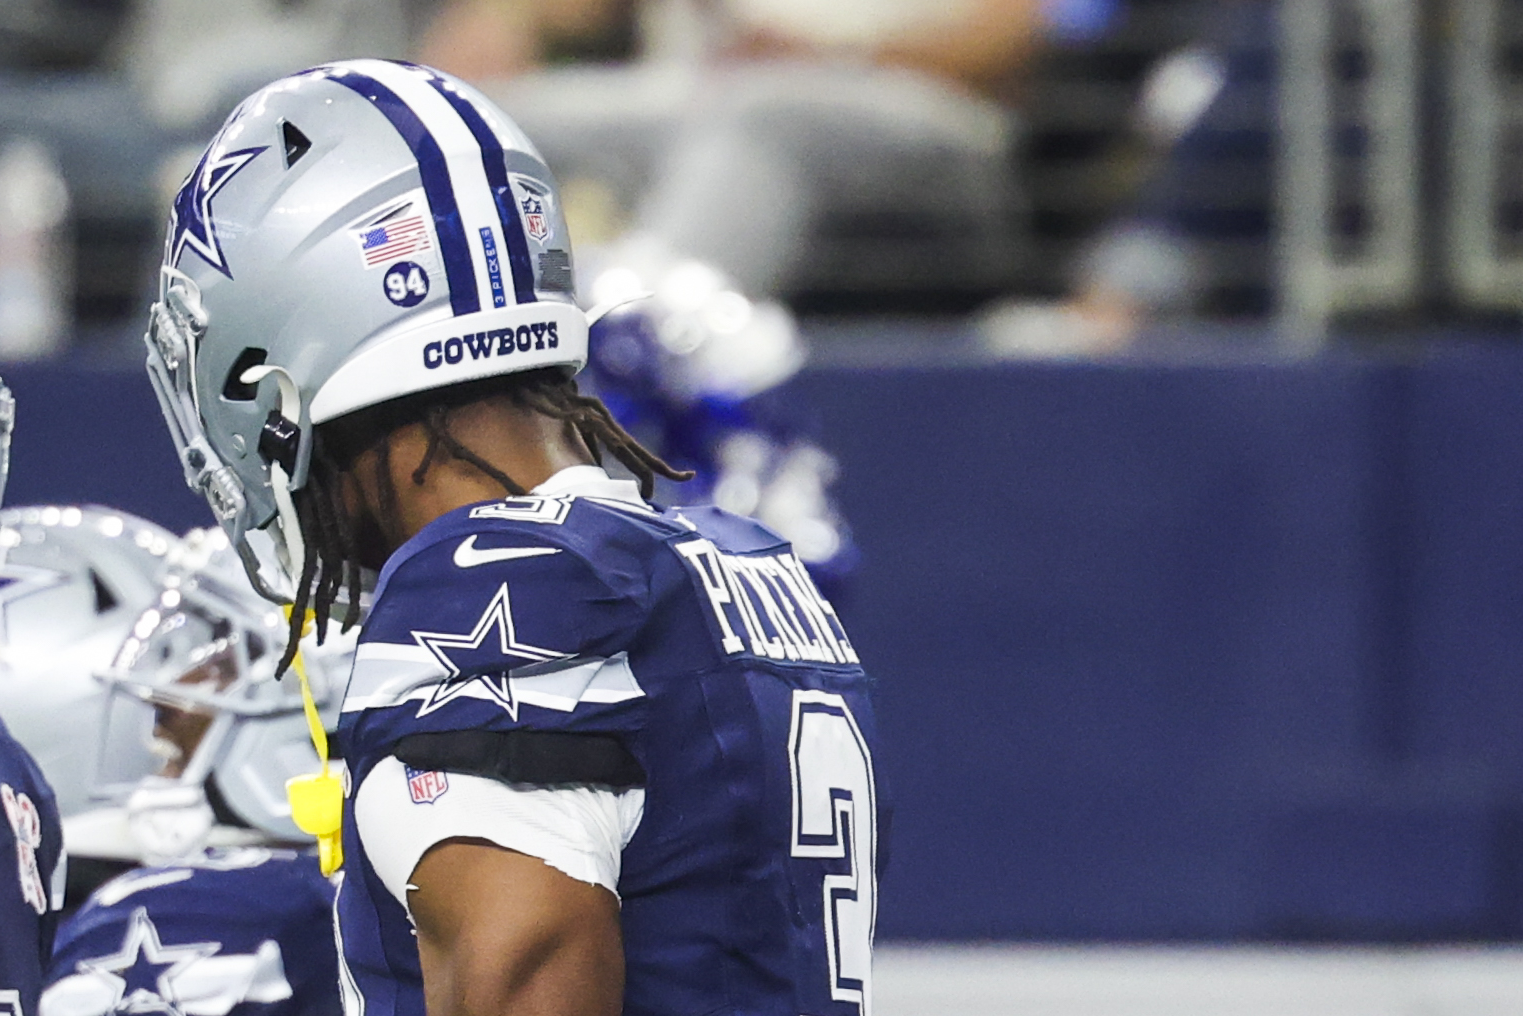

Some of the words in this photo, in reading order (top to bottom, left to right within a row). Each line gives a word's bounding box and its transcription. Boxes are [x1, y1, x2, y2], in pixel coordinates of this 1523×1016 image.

[386, 267, 427, 301] 94
[423, 321, 559, 370] COWBOYS
[410, 770, 445, 800] NFL
